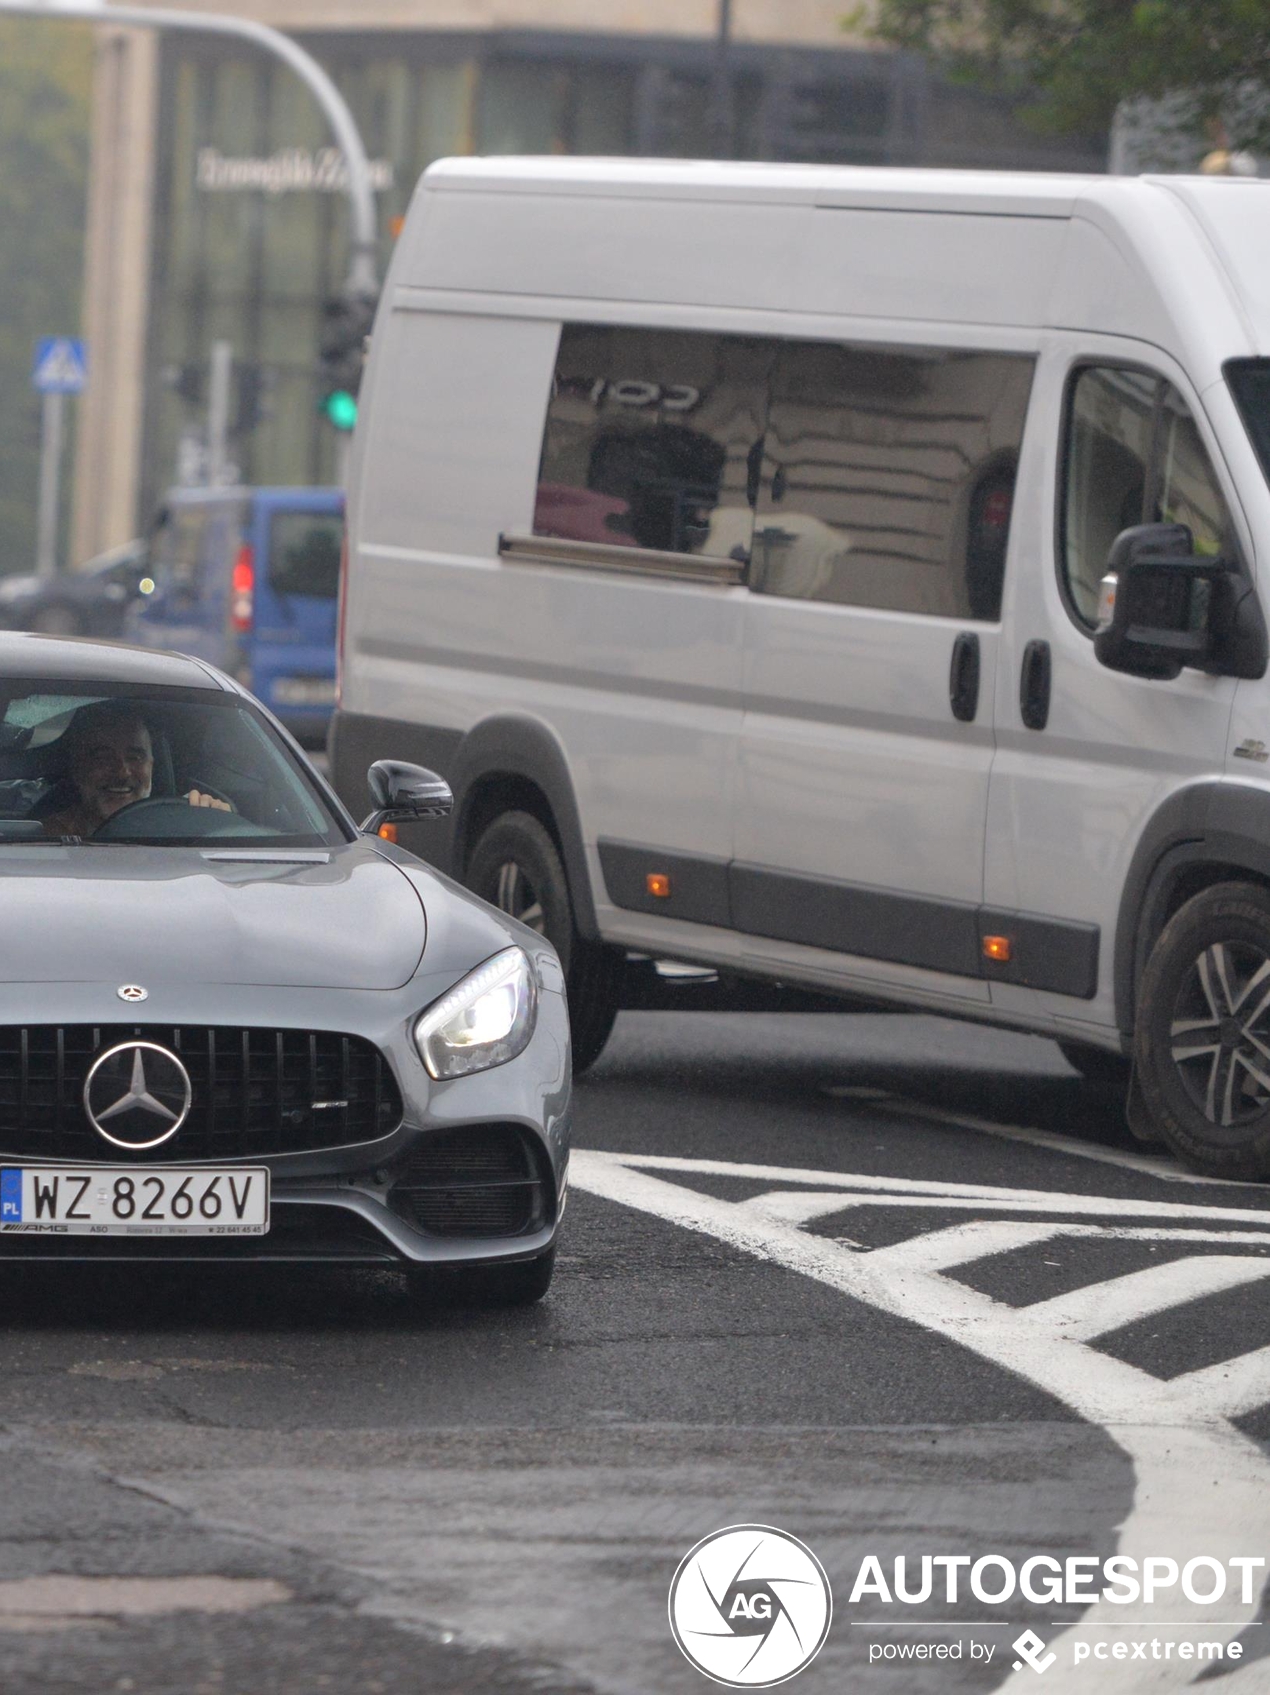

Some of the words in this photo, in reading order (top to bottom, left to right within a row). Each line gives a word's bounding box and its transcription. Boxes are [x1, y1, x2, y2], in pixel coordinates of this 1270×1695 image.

[3, 1203, 19, 1215] PL
[33, 1176, 92, 1219] WZ
[112, 1176, 253, 1220] 8266V
